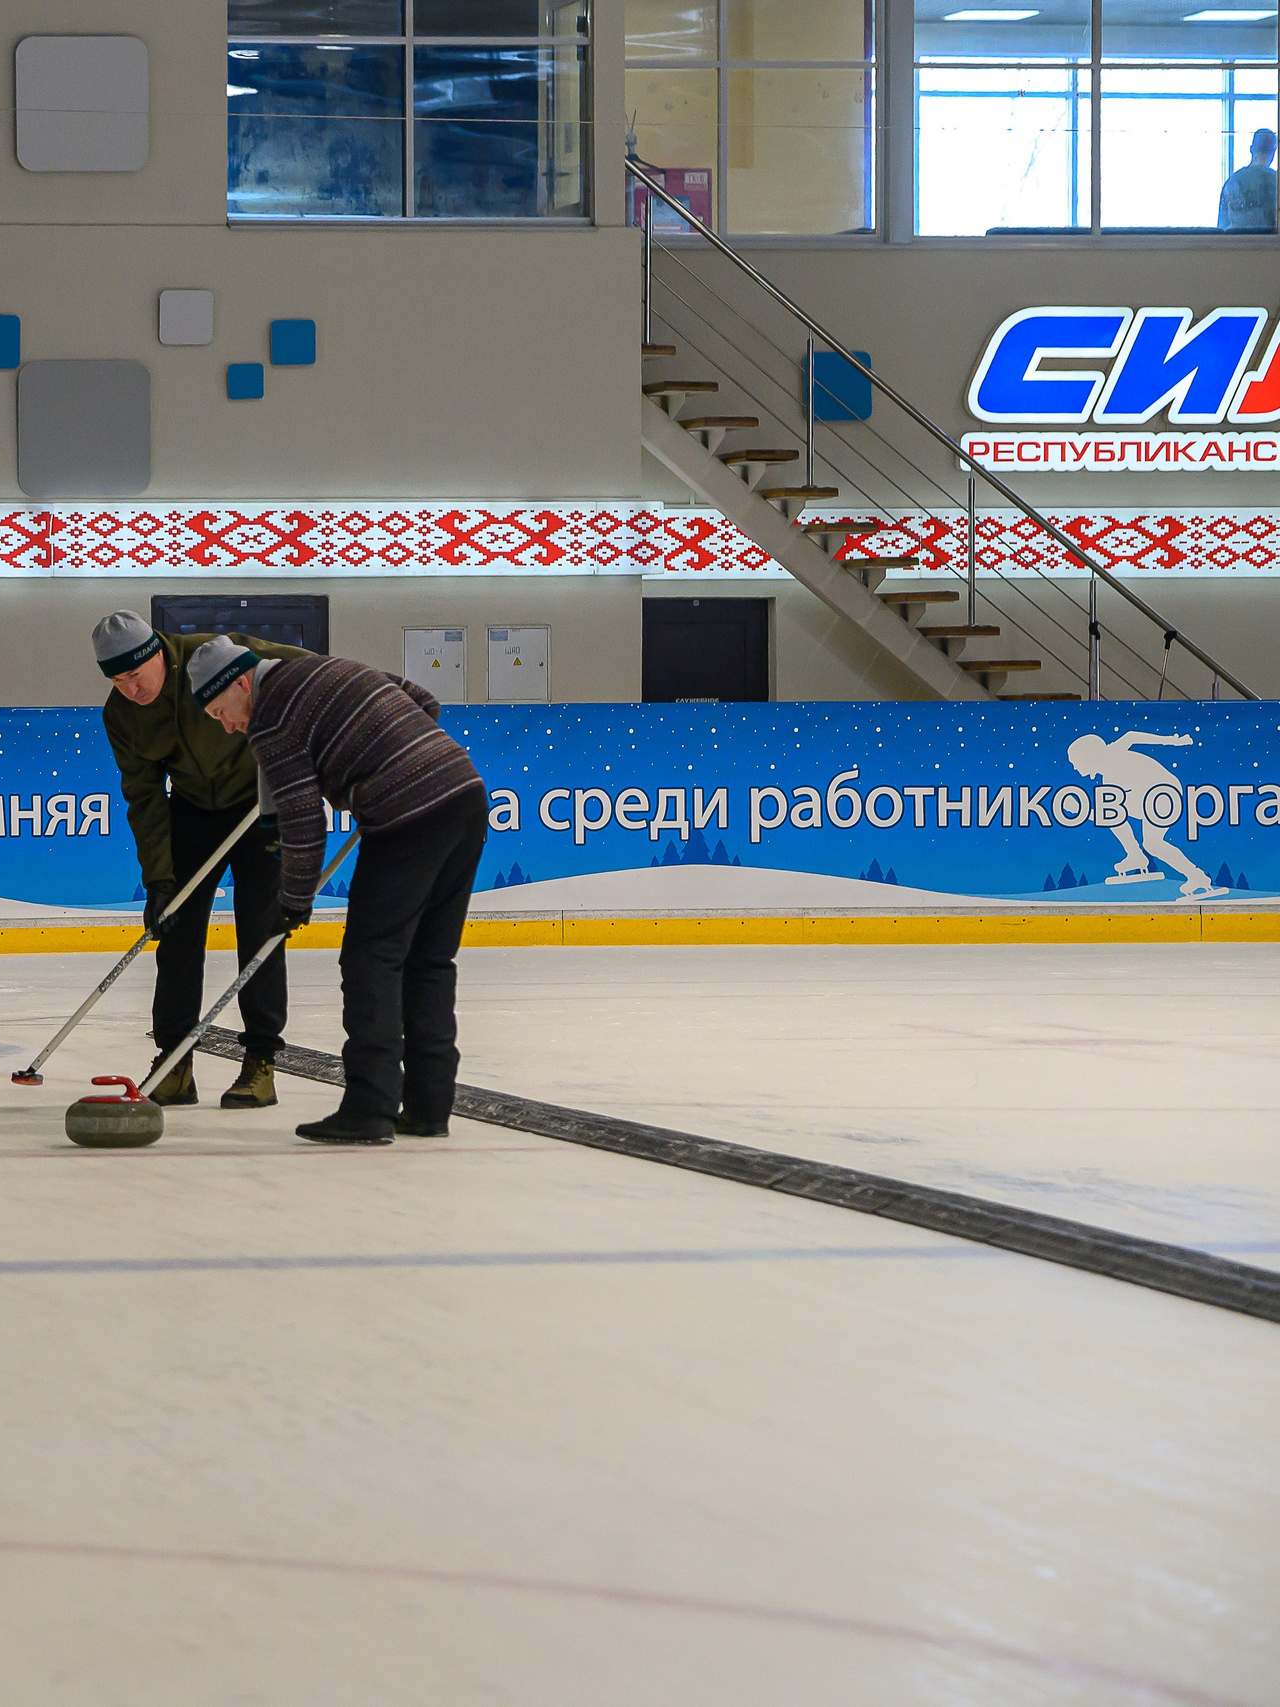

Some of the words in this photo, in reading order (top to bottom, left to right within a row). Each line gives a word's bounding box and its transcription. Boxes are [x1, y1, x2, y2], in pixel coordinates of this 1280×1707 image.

[969, 441, 1278, 462] РЕСПУБЛИКАНС
[538, 787, 728, 845] среди
[749, 769, 1129, 845] работников
